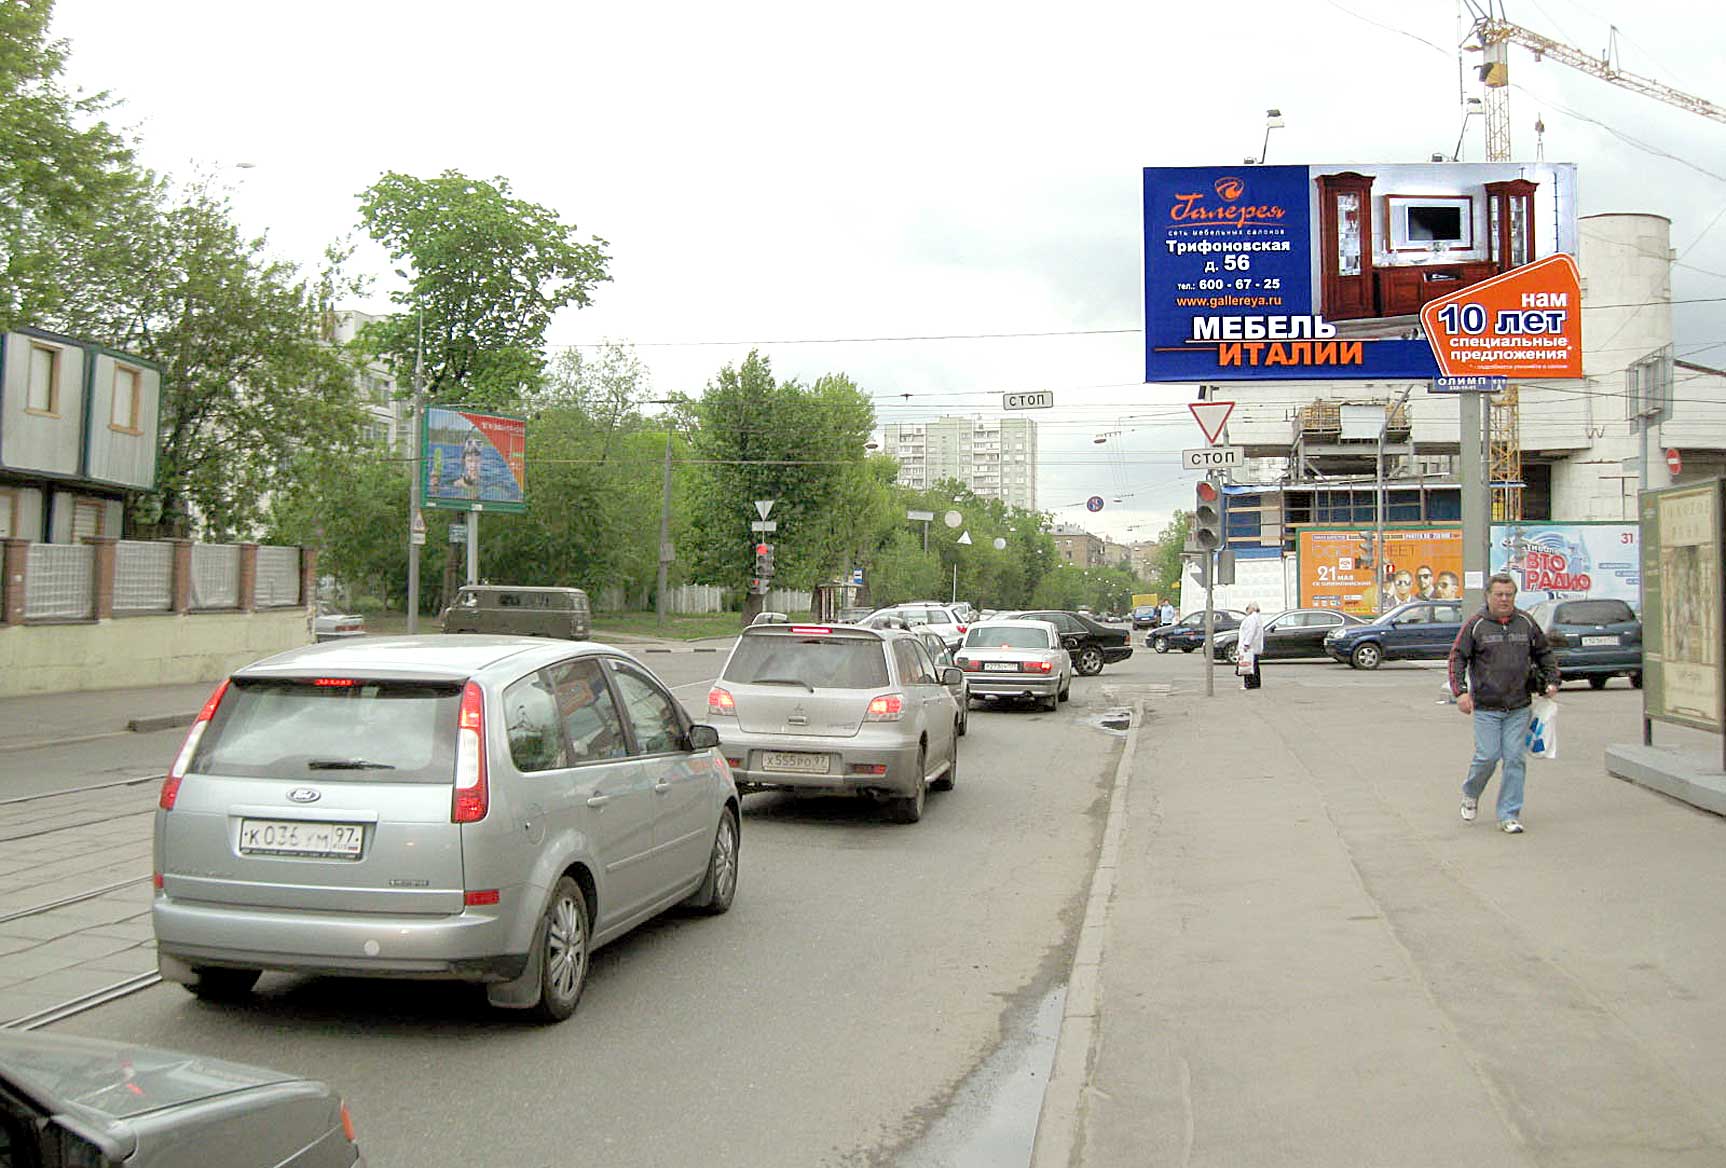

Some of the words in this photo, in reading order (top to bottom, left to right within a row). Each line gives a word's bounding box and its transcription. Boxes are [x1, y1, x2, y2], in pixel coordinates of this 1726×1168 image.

[1170, 193, 1286, 228] Галерея
[1165, 239, 1290, 255] Трифоновская
[1204, 260, 1219, 273] д.
[1224, 254, 1250, 271] 56
[1199, 279, 1223, 290] 600
[1235, 279, 1251, 290] 67
[1264, 278, 1281, 289] 25
[1176, 296, 1282, 308] www.gallereya.ru
[1521, 292, 1567, 307] нам
[1438, 303, 1487, 335] 10
[1495, 309, 1566, 335] лет
[1193, 315, 1337, 340] МЕБЕЛЬ
[1449, 337, 1568, 349] специальные
[1218, 341, 1364, 366] ИТАЛИИ
[1450, 349, 1567, 362] предложения
[1437, 377, 1486, 386] ОЛИМП
[1009, 394, 1045, 407] СТОП
[1191, 451, 1235, 465] СТОП
[1620, 533, 1634, 544] 31
[1317, 565, 1337, 581] 21
[1526, 570, 1591, 591] РАДИО
